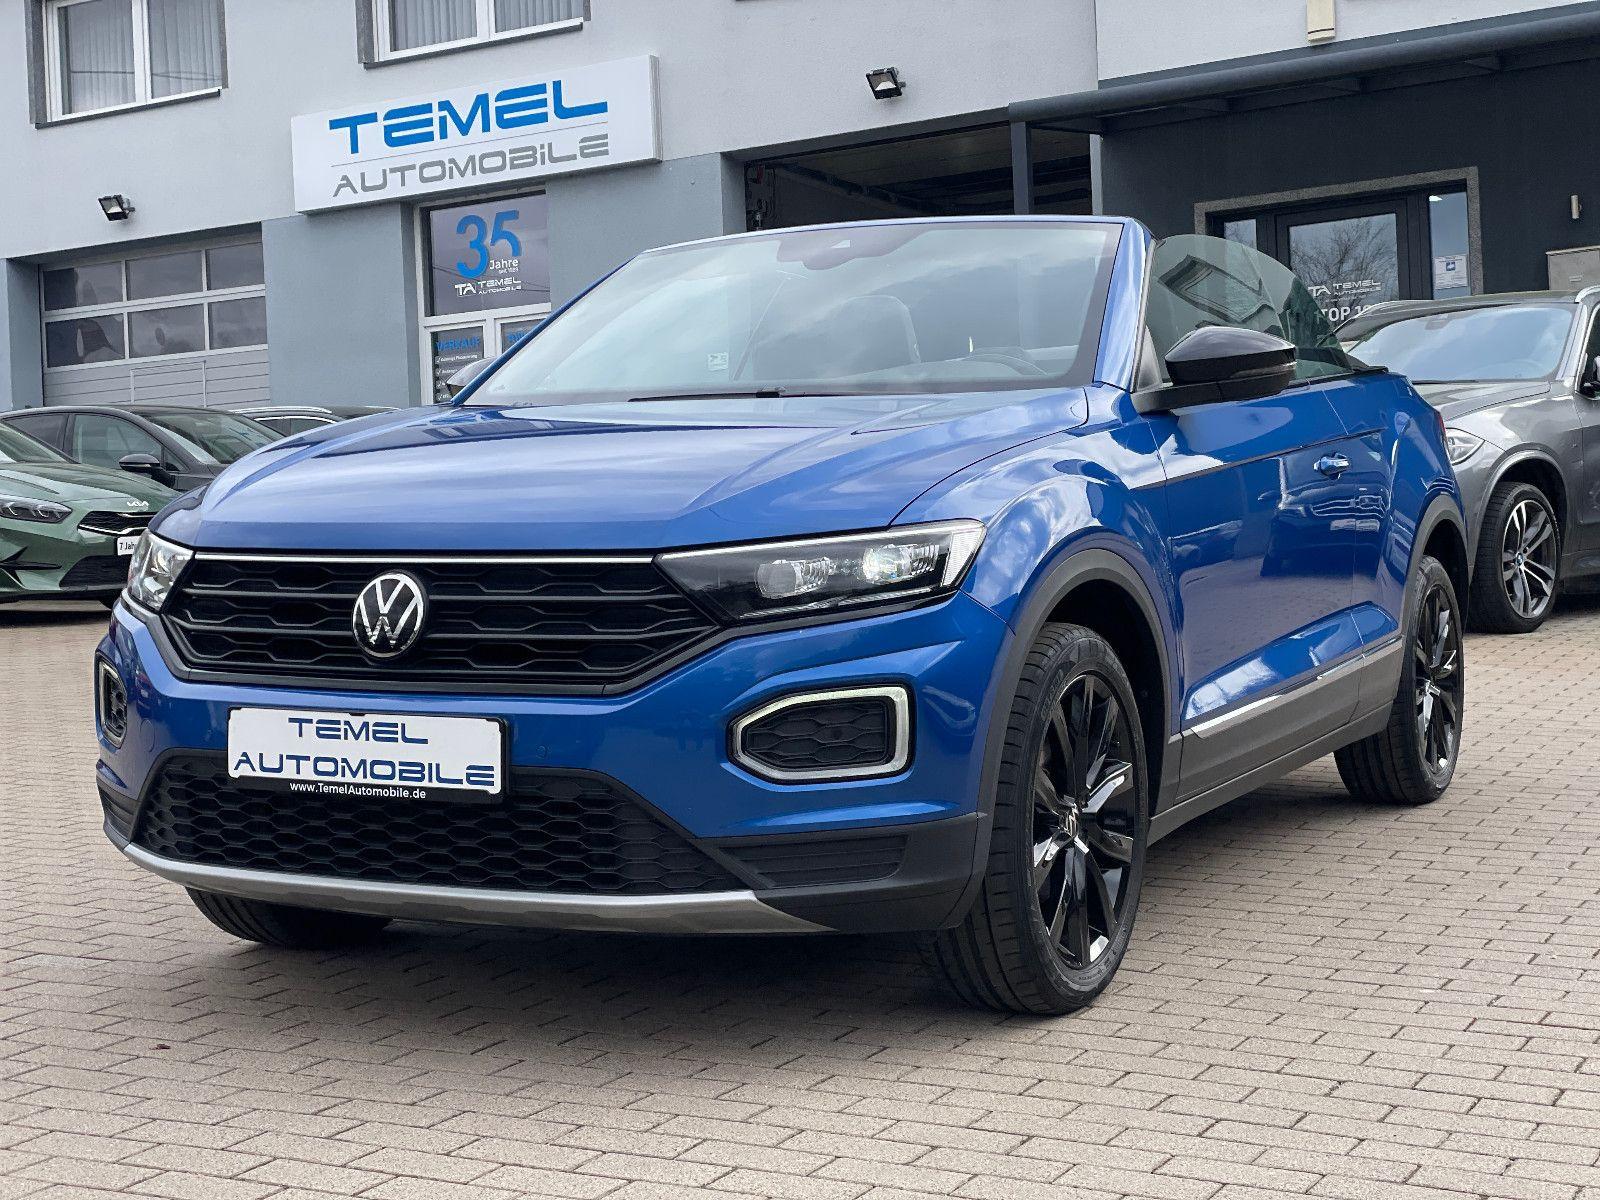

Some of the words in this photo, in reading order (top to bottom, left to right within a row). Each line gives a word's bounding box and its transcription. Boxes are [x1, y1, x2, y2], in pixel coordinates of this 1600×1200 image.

[329, 80, 608, 154] TEMEL
[332, 133, 610, 197] AUTOMOBILE
[455, 210, 522, 279] 35
[489, 258, 519, 270] Jahre
[454, 282, 477, 296] TA
[478, 277, 522, 288] TEMEL
[1307, 284, 1332, 297] TA
[1332, 279, 1381, 290] TEMEL
[288, 717, 429, 745] TEMEL
[234, 751, 495, 787] AUTOMOBILE
[289, 781, 427, 800] www.TemelAutomobile.de
